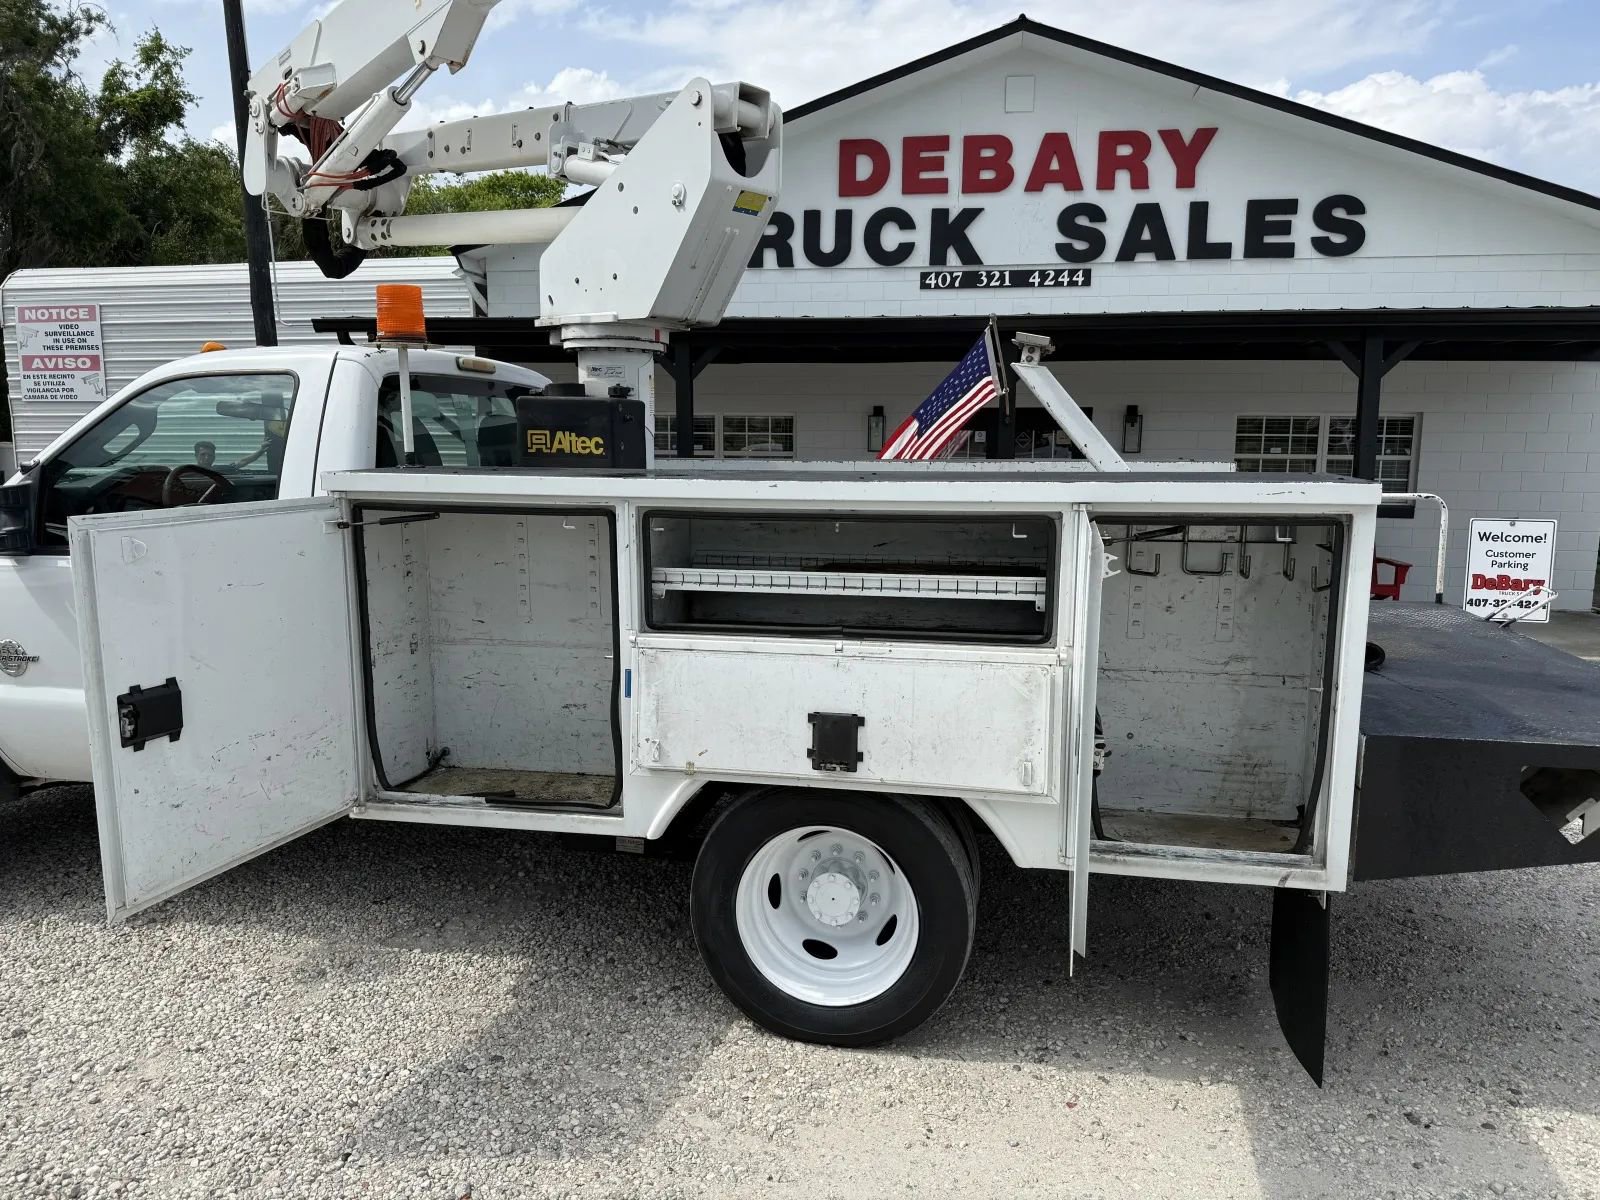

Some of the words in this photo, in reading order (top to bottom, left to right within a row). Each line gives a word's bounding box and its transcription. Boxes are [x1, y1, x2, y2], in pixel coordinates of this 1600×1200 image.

[838, 127, 1219, 197] DEBARY
[747, 206, 985, 269] RUCK
[1054, 194, 1367, 263] SALES
[925, 271, 963, 288] 407
[976, 270, 1012, 287] 321
[1028, 269, 1085, 287] 4244
[24, 308, 90, 320] NOTICE
[31, 357, 91, 369] AVISO
[551, 430, 605, 455] Altec
[1477, 531, 1547, 544] Welcome!
[1485, 549, 1537, 559] Customer
[1491, 560, 1529, 571] Parking
[1471, 573, 1546, 596] DeBary
